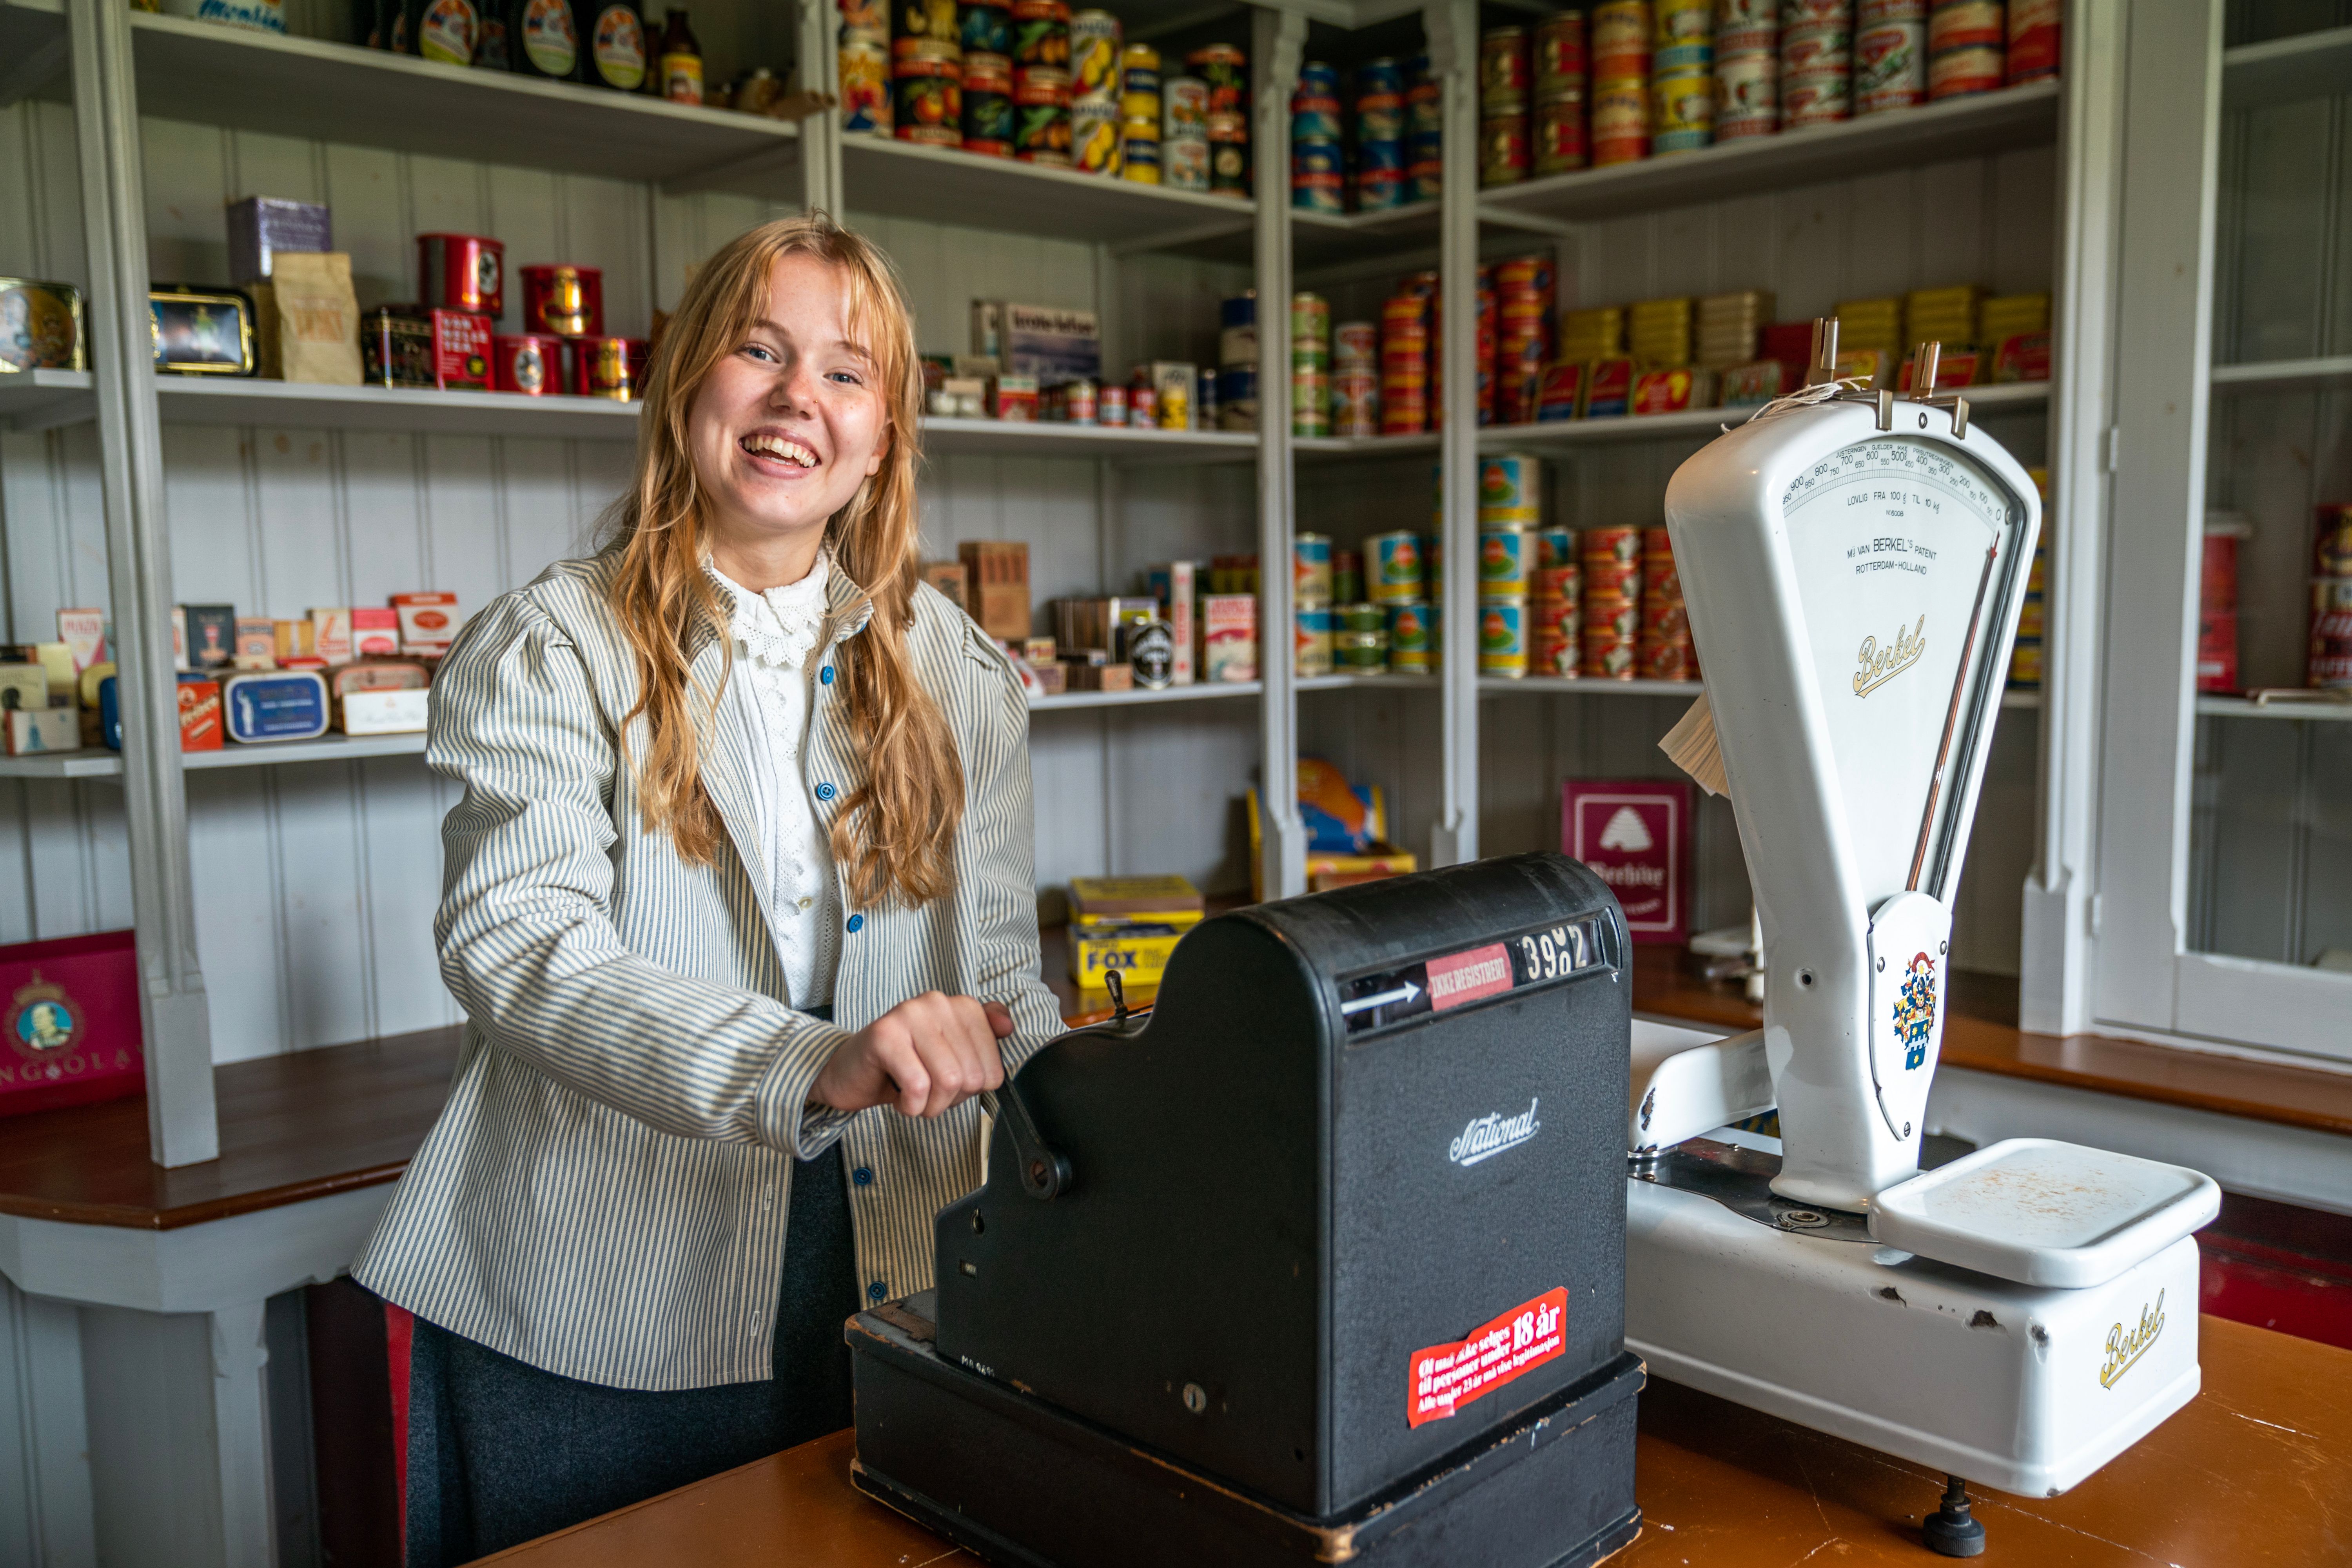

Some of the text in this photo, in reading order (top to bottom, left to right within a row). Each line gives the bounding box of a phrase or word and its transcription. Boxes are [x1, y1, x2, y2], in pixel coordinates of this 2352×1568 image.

[1836, 446, 1867, 458] JUSTERINGEN
[1782, 493, 1791, 505] 950
[1805, 478, 1815, 489] 850
[1829, 467, 1839, 477] 750
[1855, 460, 1864, 468] 650
[1928, 466, 1937, 475] 350
[1949, 477, 1958, 487] 250
[1790, 476, 1804, 491] 900
[1815, 463, 1828, 476] 800
[1841, 455, 1853, 466] 700
[1866, 451, 1878, 461] 600
[1916, 455, 1927, 466] 400
[1938, 463, 1950, 475] 300
[1959, 475, 1970, 488] 200
[1979, 491, 1988, 504] 100
[1847, 493, 1867, 506] LOVLIG
[1874, 492, 1886, 500] FRA
[1891, 492, 1900, 500] 100
[1926, 498, 1931, 507] 10
[1857, 545, 1870, 555] VAN
[1915, 546, 1936, 561] PATENT
[1853, 614, 1925, 699] Berkel
[1430, 971, 1455, 999] IKKE
[1450, 1097, 1540, 1166] National
[1419, 1375, 1432, 1396] til
[1481, 1342, 1511, 1367] under
[1512, 1311, 1534, 1352] 18
[1536, 1303, 1561, 1339] år
[1479, 1327, 1510, 1349] selges
[2100, 1288, 2165, 1390] Berkel
